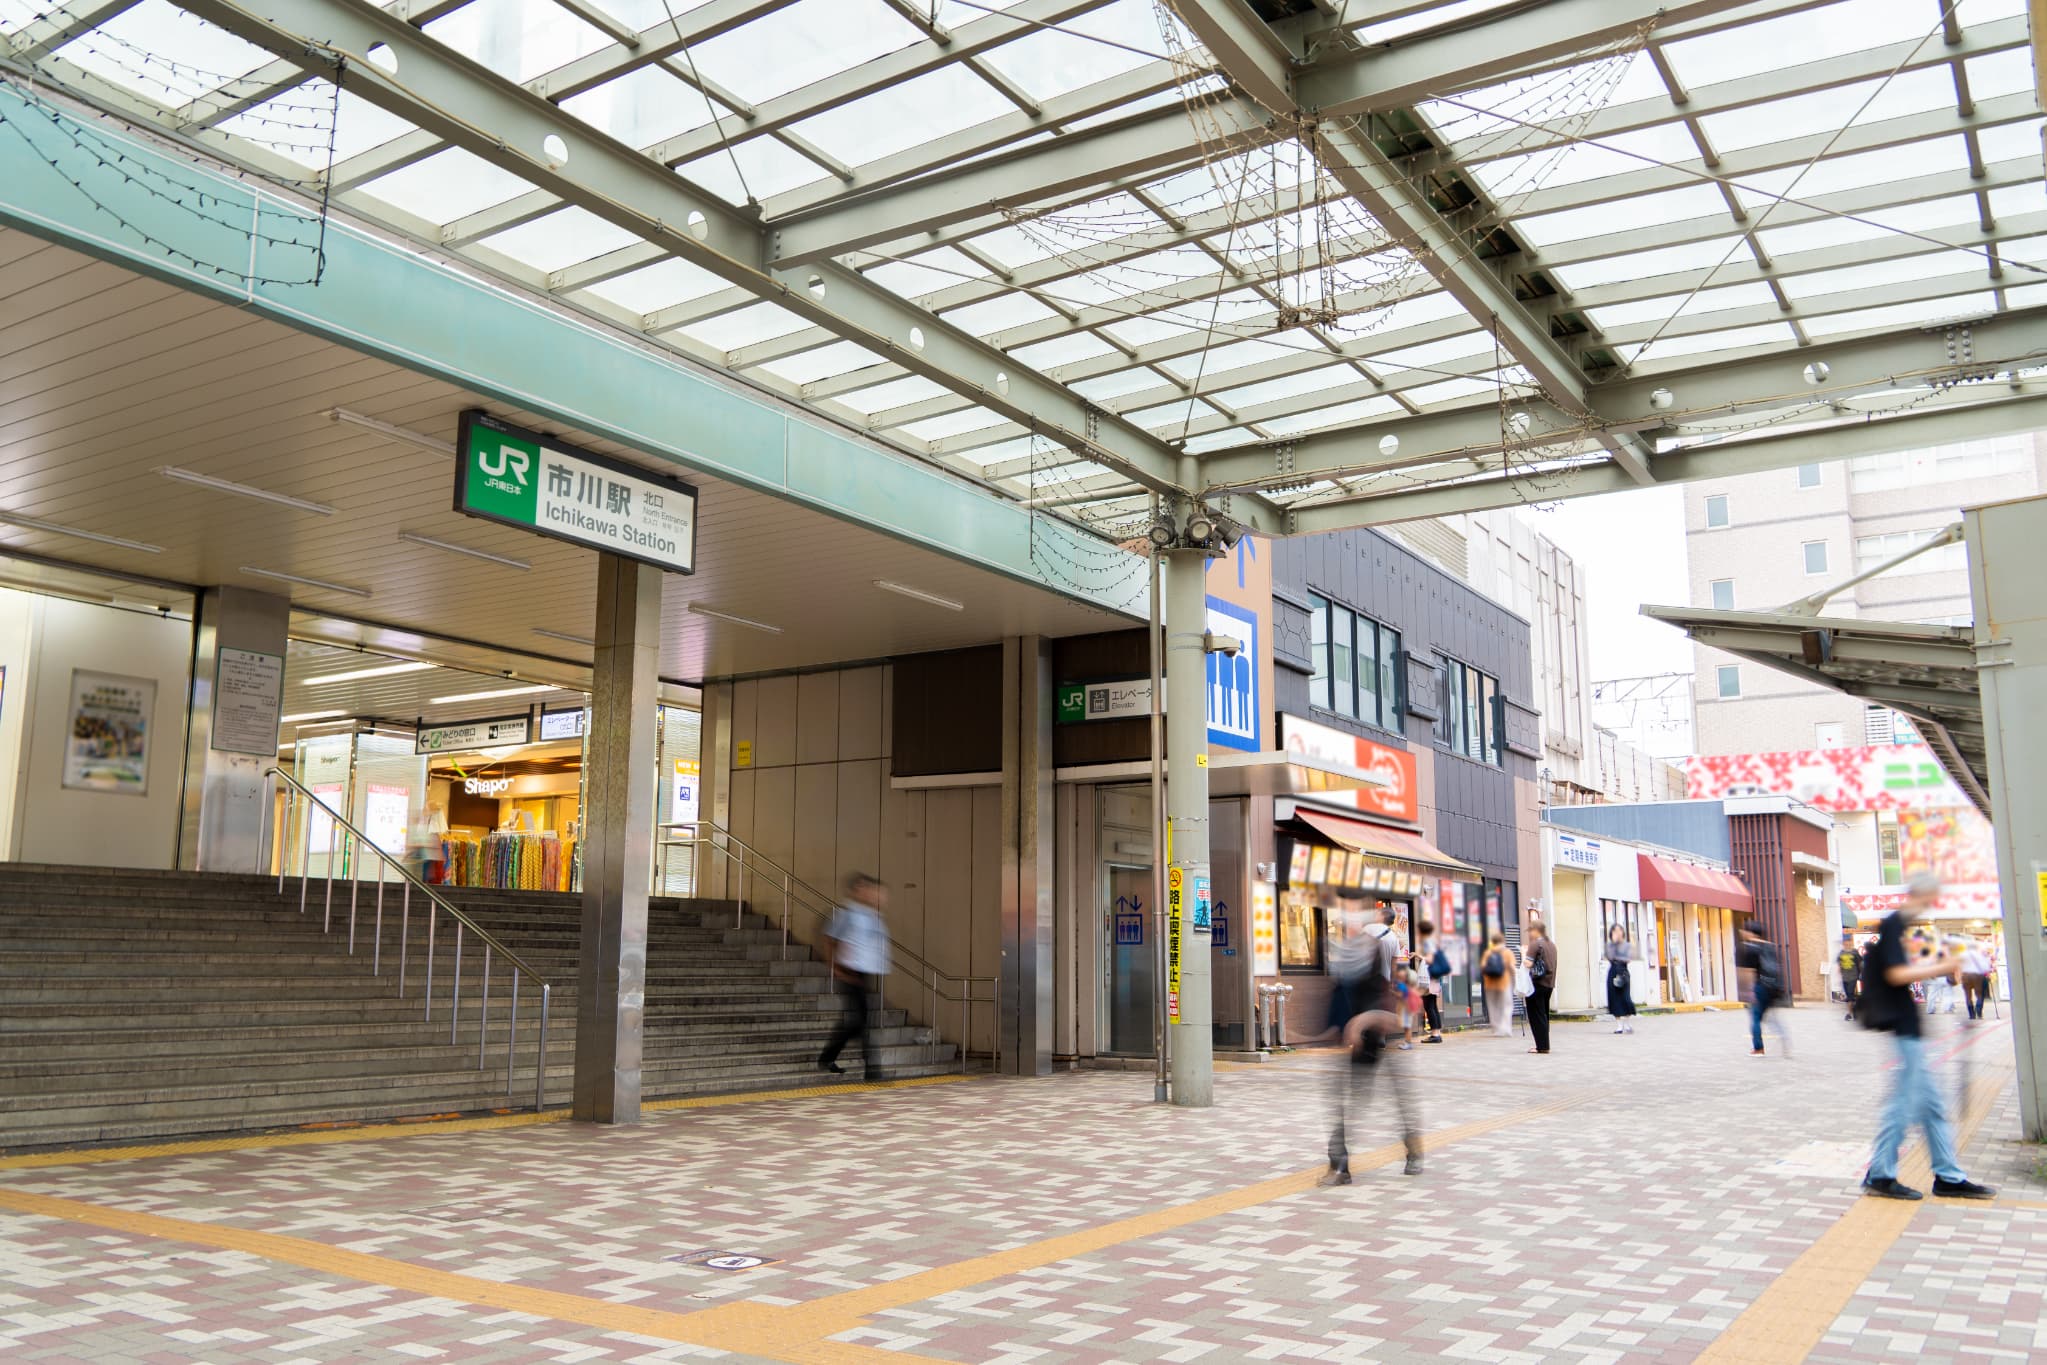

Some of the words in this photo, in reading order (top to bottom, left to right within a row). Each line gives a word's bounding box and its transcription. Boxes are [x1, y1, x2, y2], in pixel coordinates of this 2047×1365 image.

[479, 444, 530, 486] JR
[484, 480, 522, 496] JR東日本
[547, 463, 632, 518] 市川駅
[643, 491, 664, 508] 北口
[642, 506, 660, 519] North
[661, 511, 689, 527] Entrance
[546, 501, 617, 537] Ichikawa
[622, 524, 676, 554] Station
[1062, 692, 1084, 707] JR
[1111, 702, 1136, 710] Elevator
[442, 728, 476, 739] みどりの窓口
[1169, 889, 1180, 983] 路上喫煙禁止
